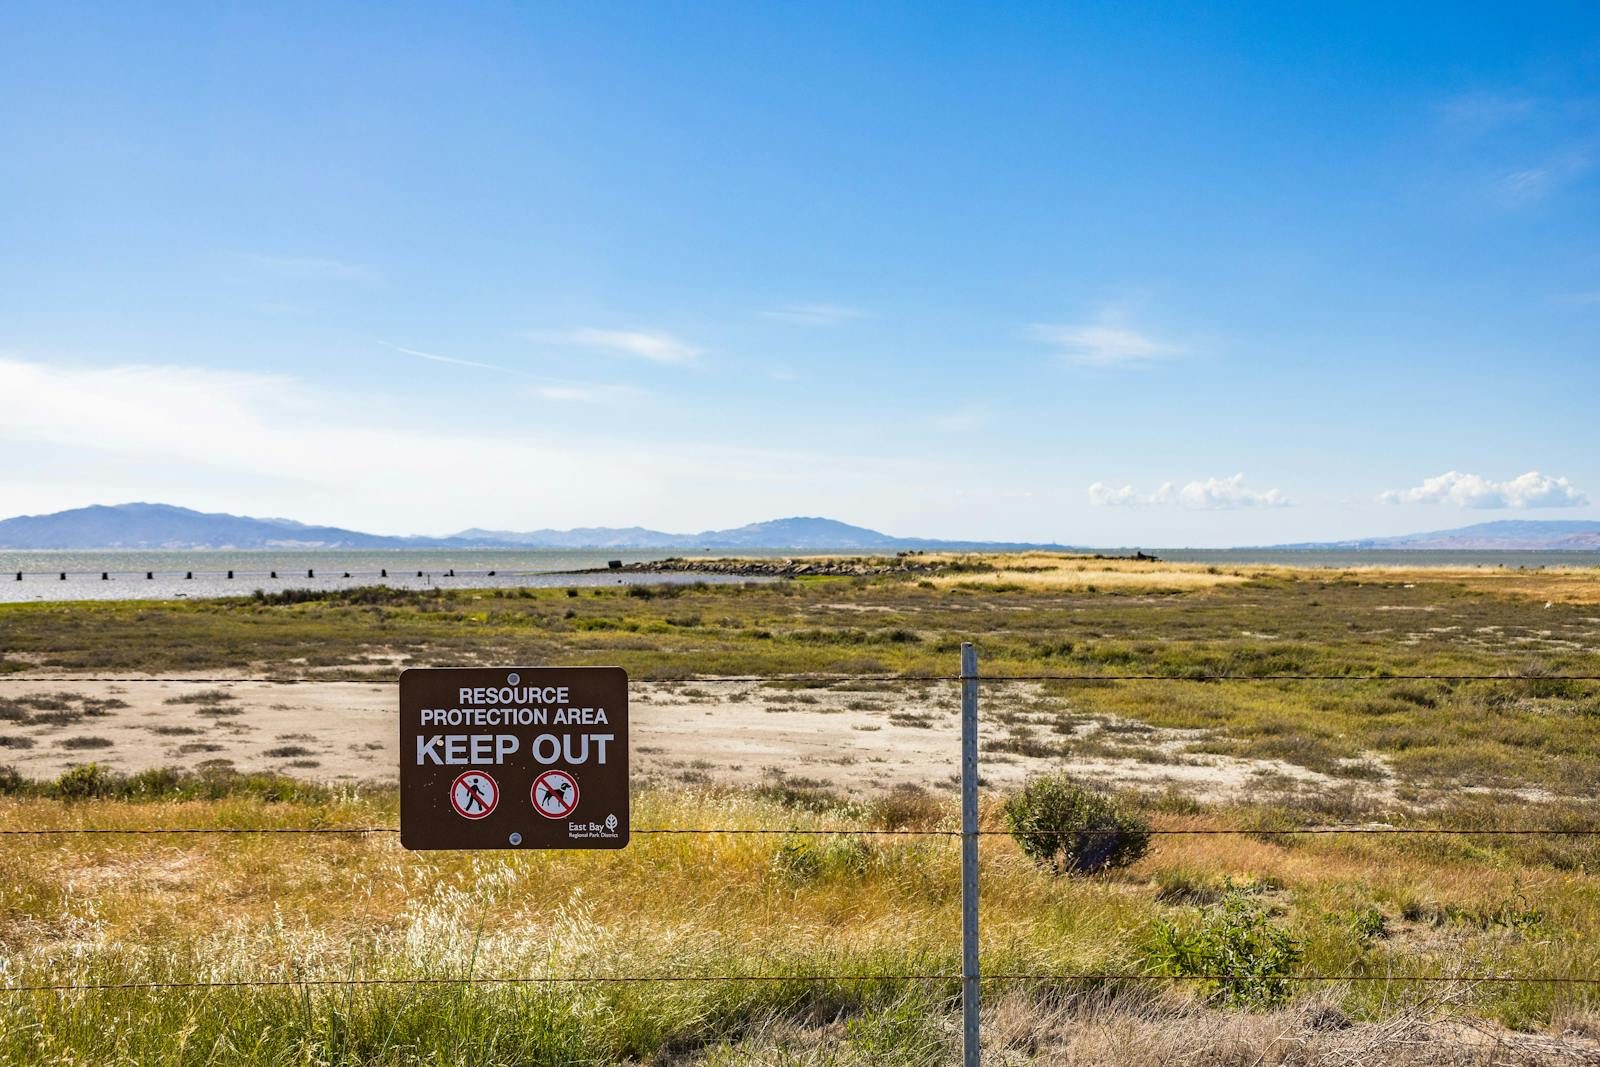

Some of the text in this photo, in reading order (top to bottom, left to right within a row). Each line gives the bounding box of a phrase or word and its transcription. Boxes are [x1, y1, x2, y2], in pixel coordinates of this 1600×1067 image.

[459, 687, 569, 704] RESOURCE
[420, 708, 608, 725] PROTECTION AREA
[416, 734, 614, 764] KEEP OUT
[568, 822, 605, 833] East Bay
